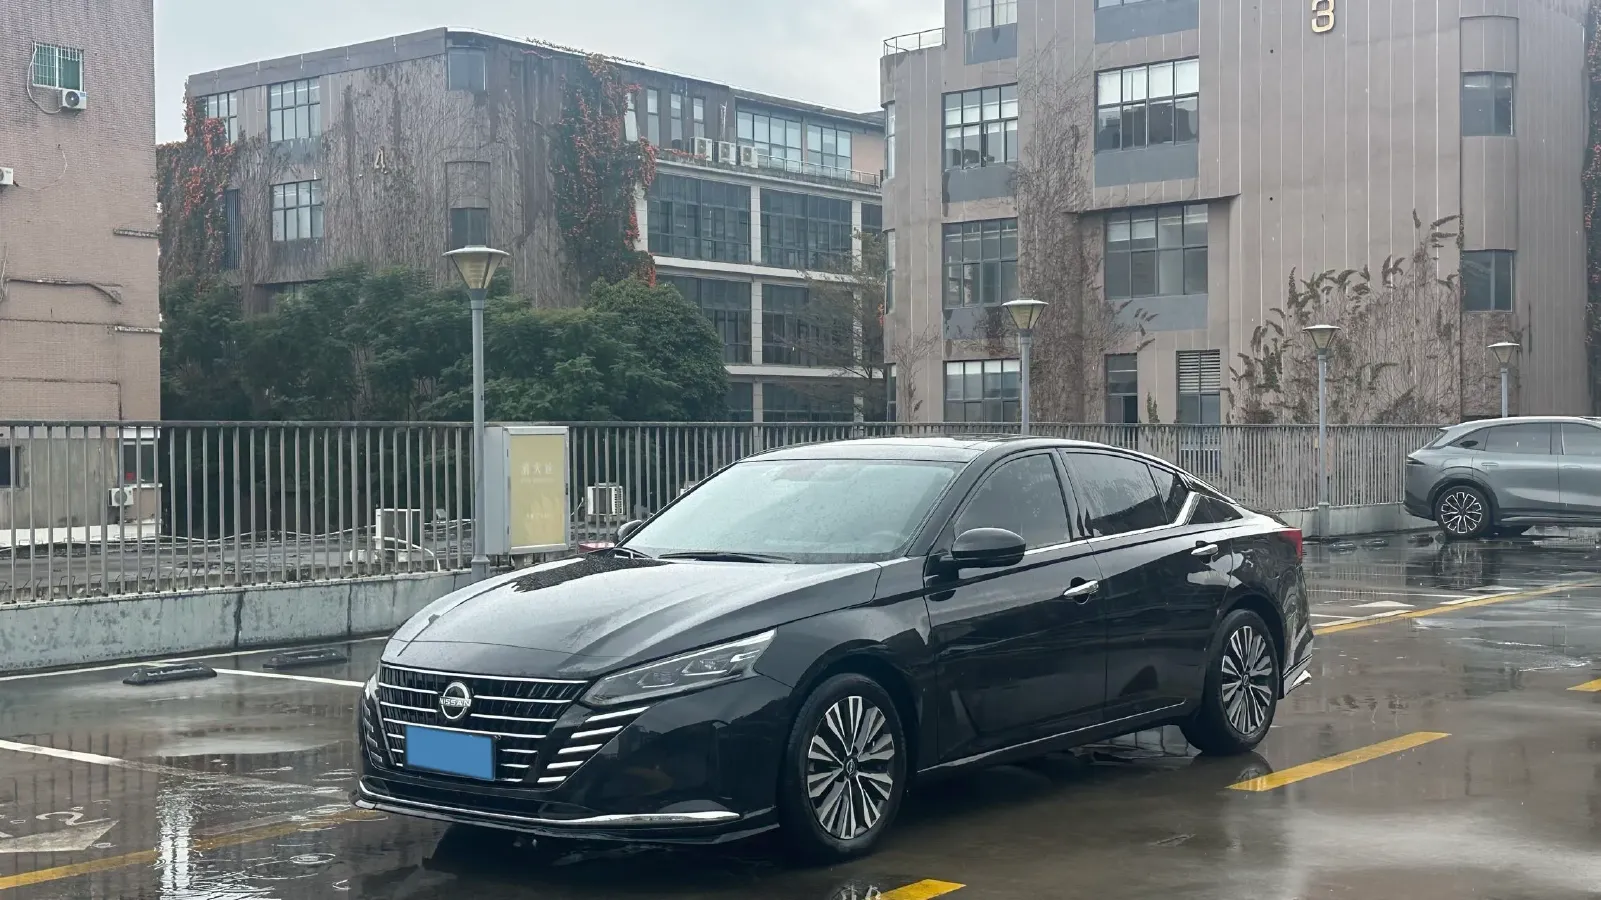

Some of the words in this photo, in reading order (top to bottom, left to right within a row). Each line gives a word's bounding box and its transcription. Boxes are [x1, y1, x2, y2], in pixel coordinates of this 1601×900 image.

[1311, 0, 1335, 33] 3
[374, 147, 386, 173] 4
[440, 697, 472, 707] NISSAN
